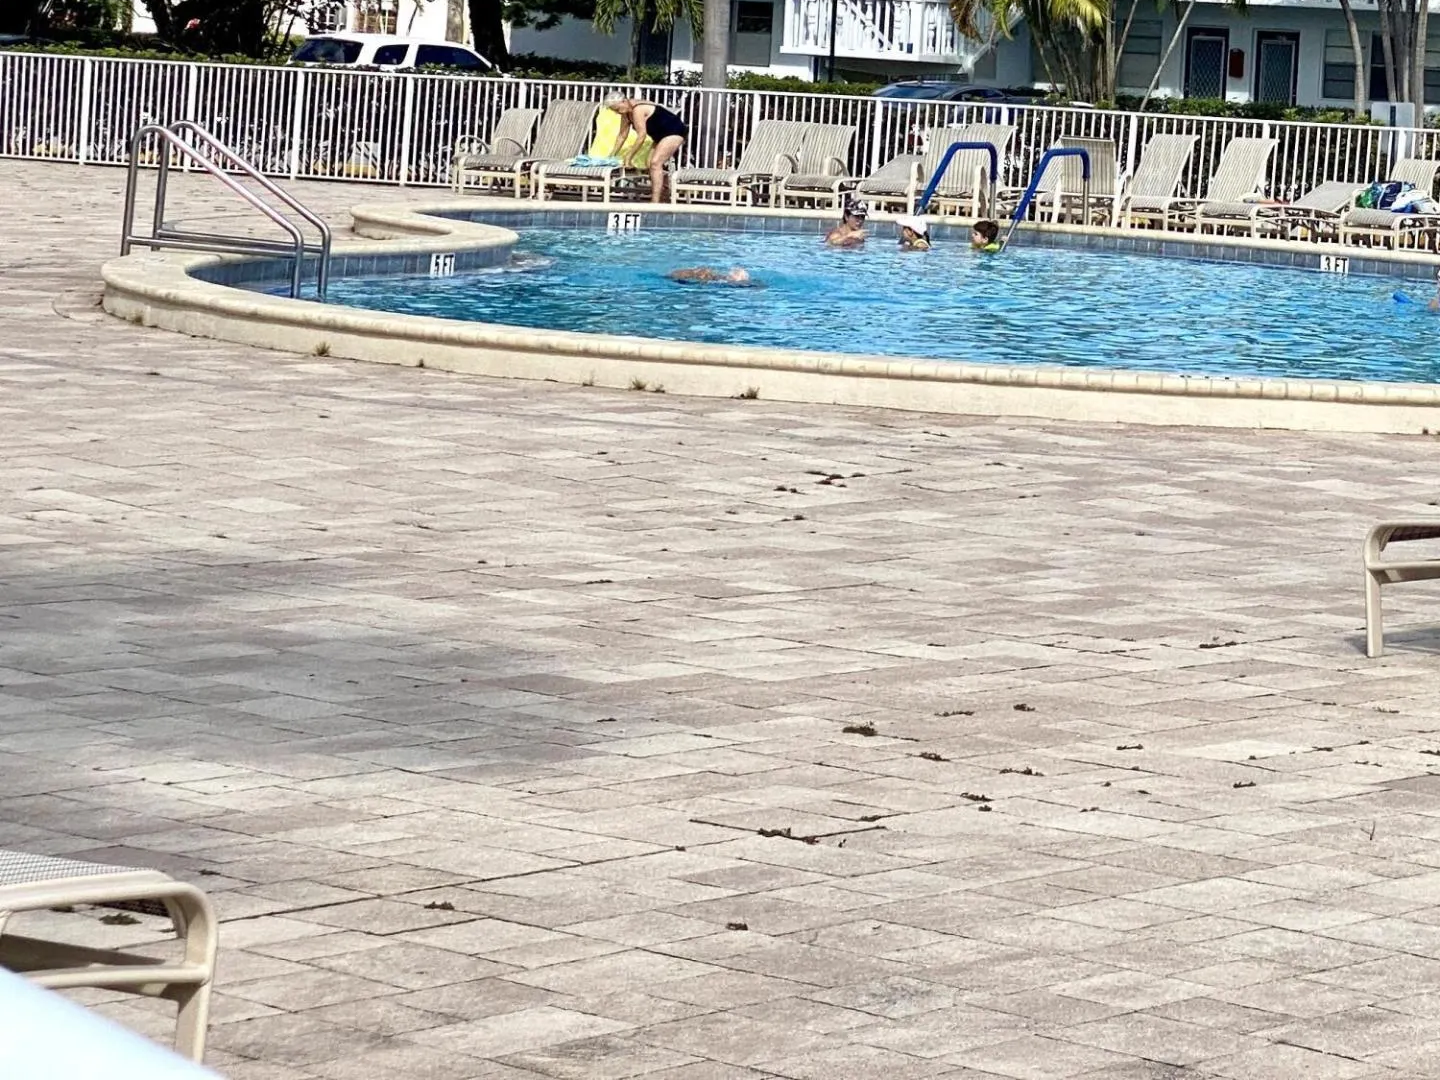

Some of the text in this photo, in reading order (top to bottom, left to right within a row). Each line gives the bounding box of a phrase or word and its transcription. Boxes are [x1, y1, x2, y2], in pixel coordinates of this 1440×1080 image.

[613, 213, 640, 229] 3 FT
[434, 254, 454, 273] 5 FT
[1324, 256, 1348, 273] 3 FT
